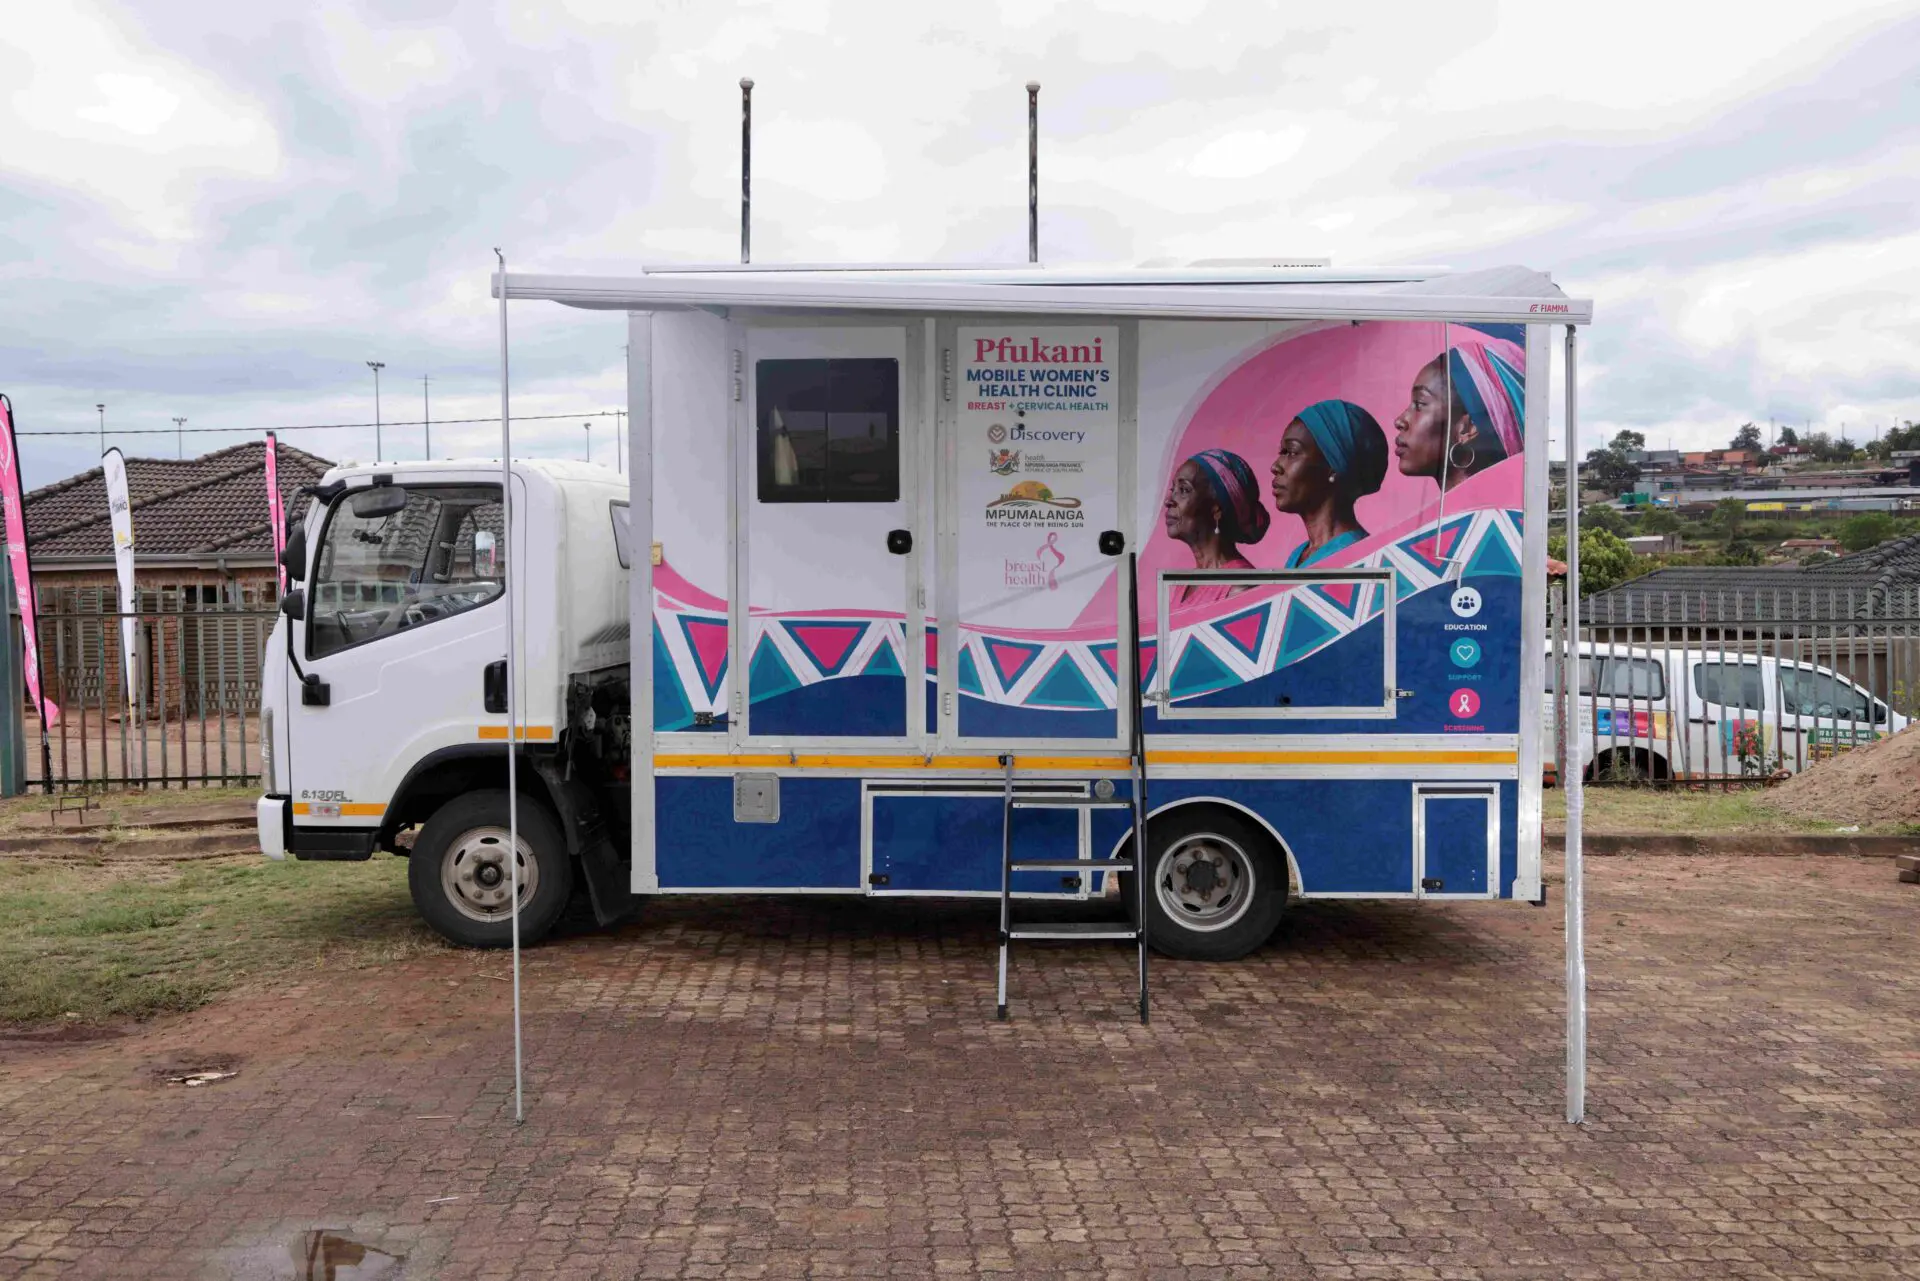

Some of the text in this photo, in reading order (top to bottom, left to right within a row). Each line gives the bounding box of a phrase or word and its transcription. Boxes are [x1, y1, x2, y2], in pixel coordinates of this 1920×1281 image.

[1540, 304, 1569, 312] FIAMMA
[974, 337, 1103, 363] Pfukani
[967, 369, 1025, 382] MOBILE
[979, 384, 1097, 397] HEALTH CLINIC
[968, 402, 1005, 410] BREAST
[1017, 402, 1067, 410] CERVICAL
[1070, 402, 1108, 410] HEALTH
[1010, 428, 1085, 443] Discovery
[986, 510, 1084, 520] MPUMALANGA
[1005, 559, 1047, 572] breast
[1005, 572, 1045, 585] health
